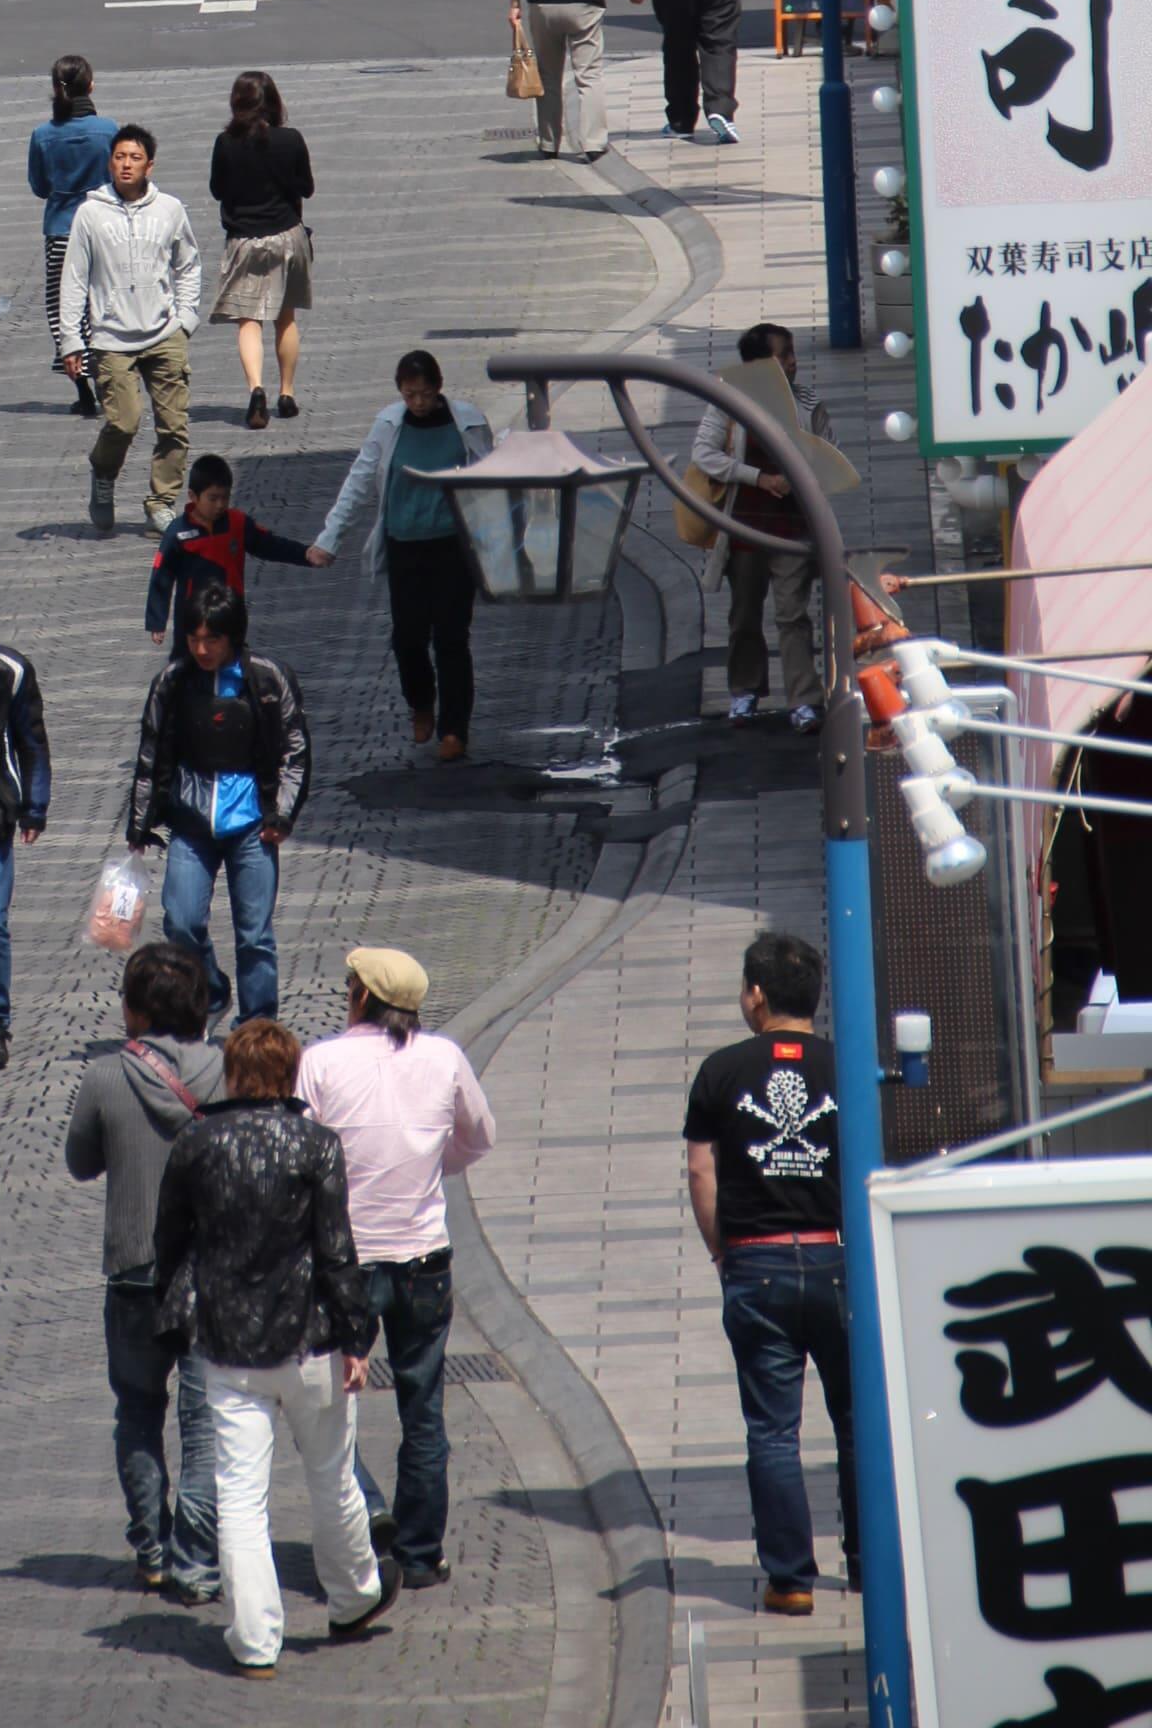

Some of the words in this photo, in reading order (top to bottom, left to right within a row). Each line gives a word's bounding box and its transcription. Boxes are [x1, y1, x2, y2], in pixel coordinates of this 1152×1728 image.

[965, 236, 1152, 278] 双葉寿司支店
